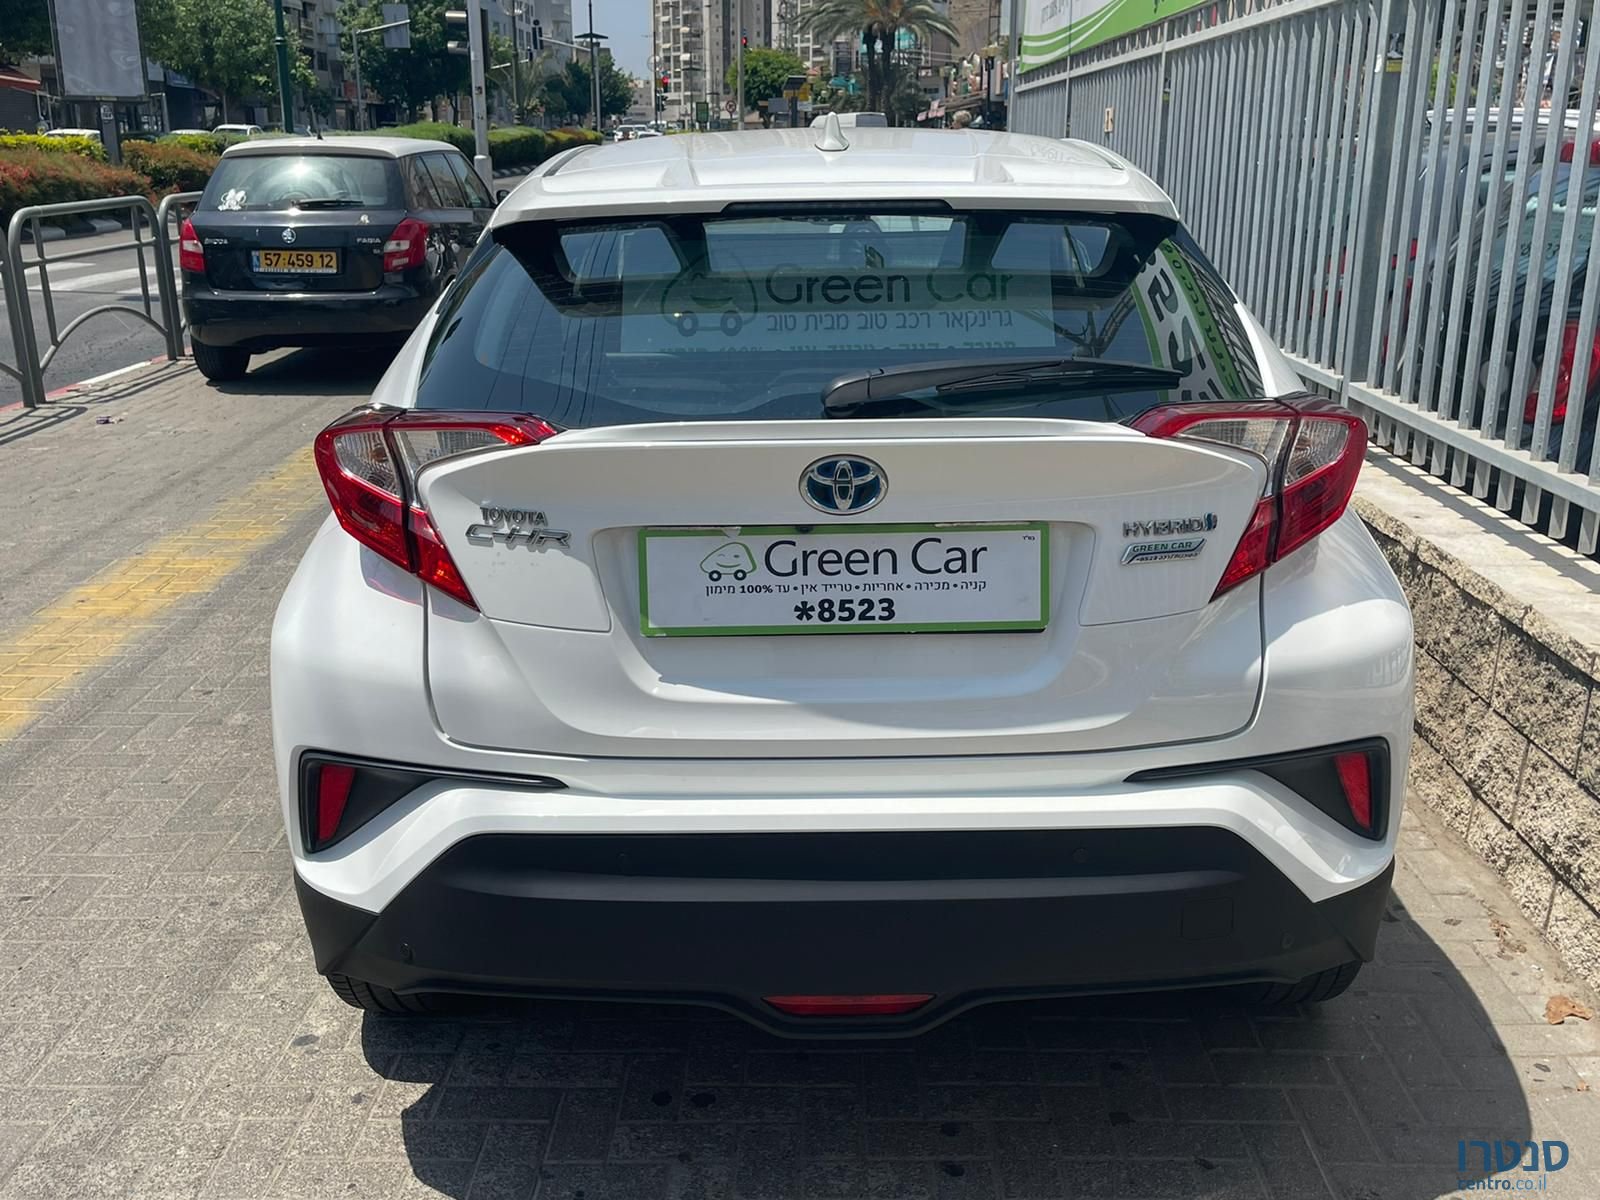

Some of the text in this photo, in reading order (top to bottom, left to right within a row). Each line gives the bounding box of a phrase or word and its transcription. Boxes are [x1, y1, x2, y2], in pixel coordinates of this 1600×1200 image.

[765, 263, 1015, 306] Green Car
[767, 310, 1013, 332] גרינקאר רכב טוב מבית טוב
[480, 506, 547, 526] TOYOTA
[465, 523, 571, 550] C-HR
[1122, 518, 1202, 537] HYBRID
[764, 537, 987, 578] Green Car
[1132, 541, 1193, 553] GREEN CAR
[705, 580, 987, 597] קניה מכירה אחריות טרייד אין עד 100% מימון
